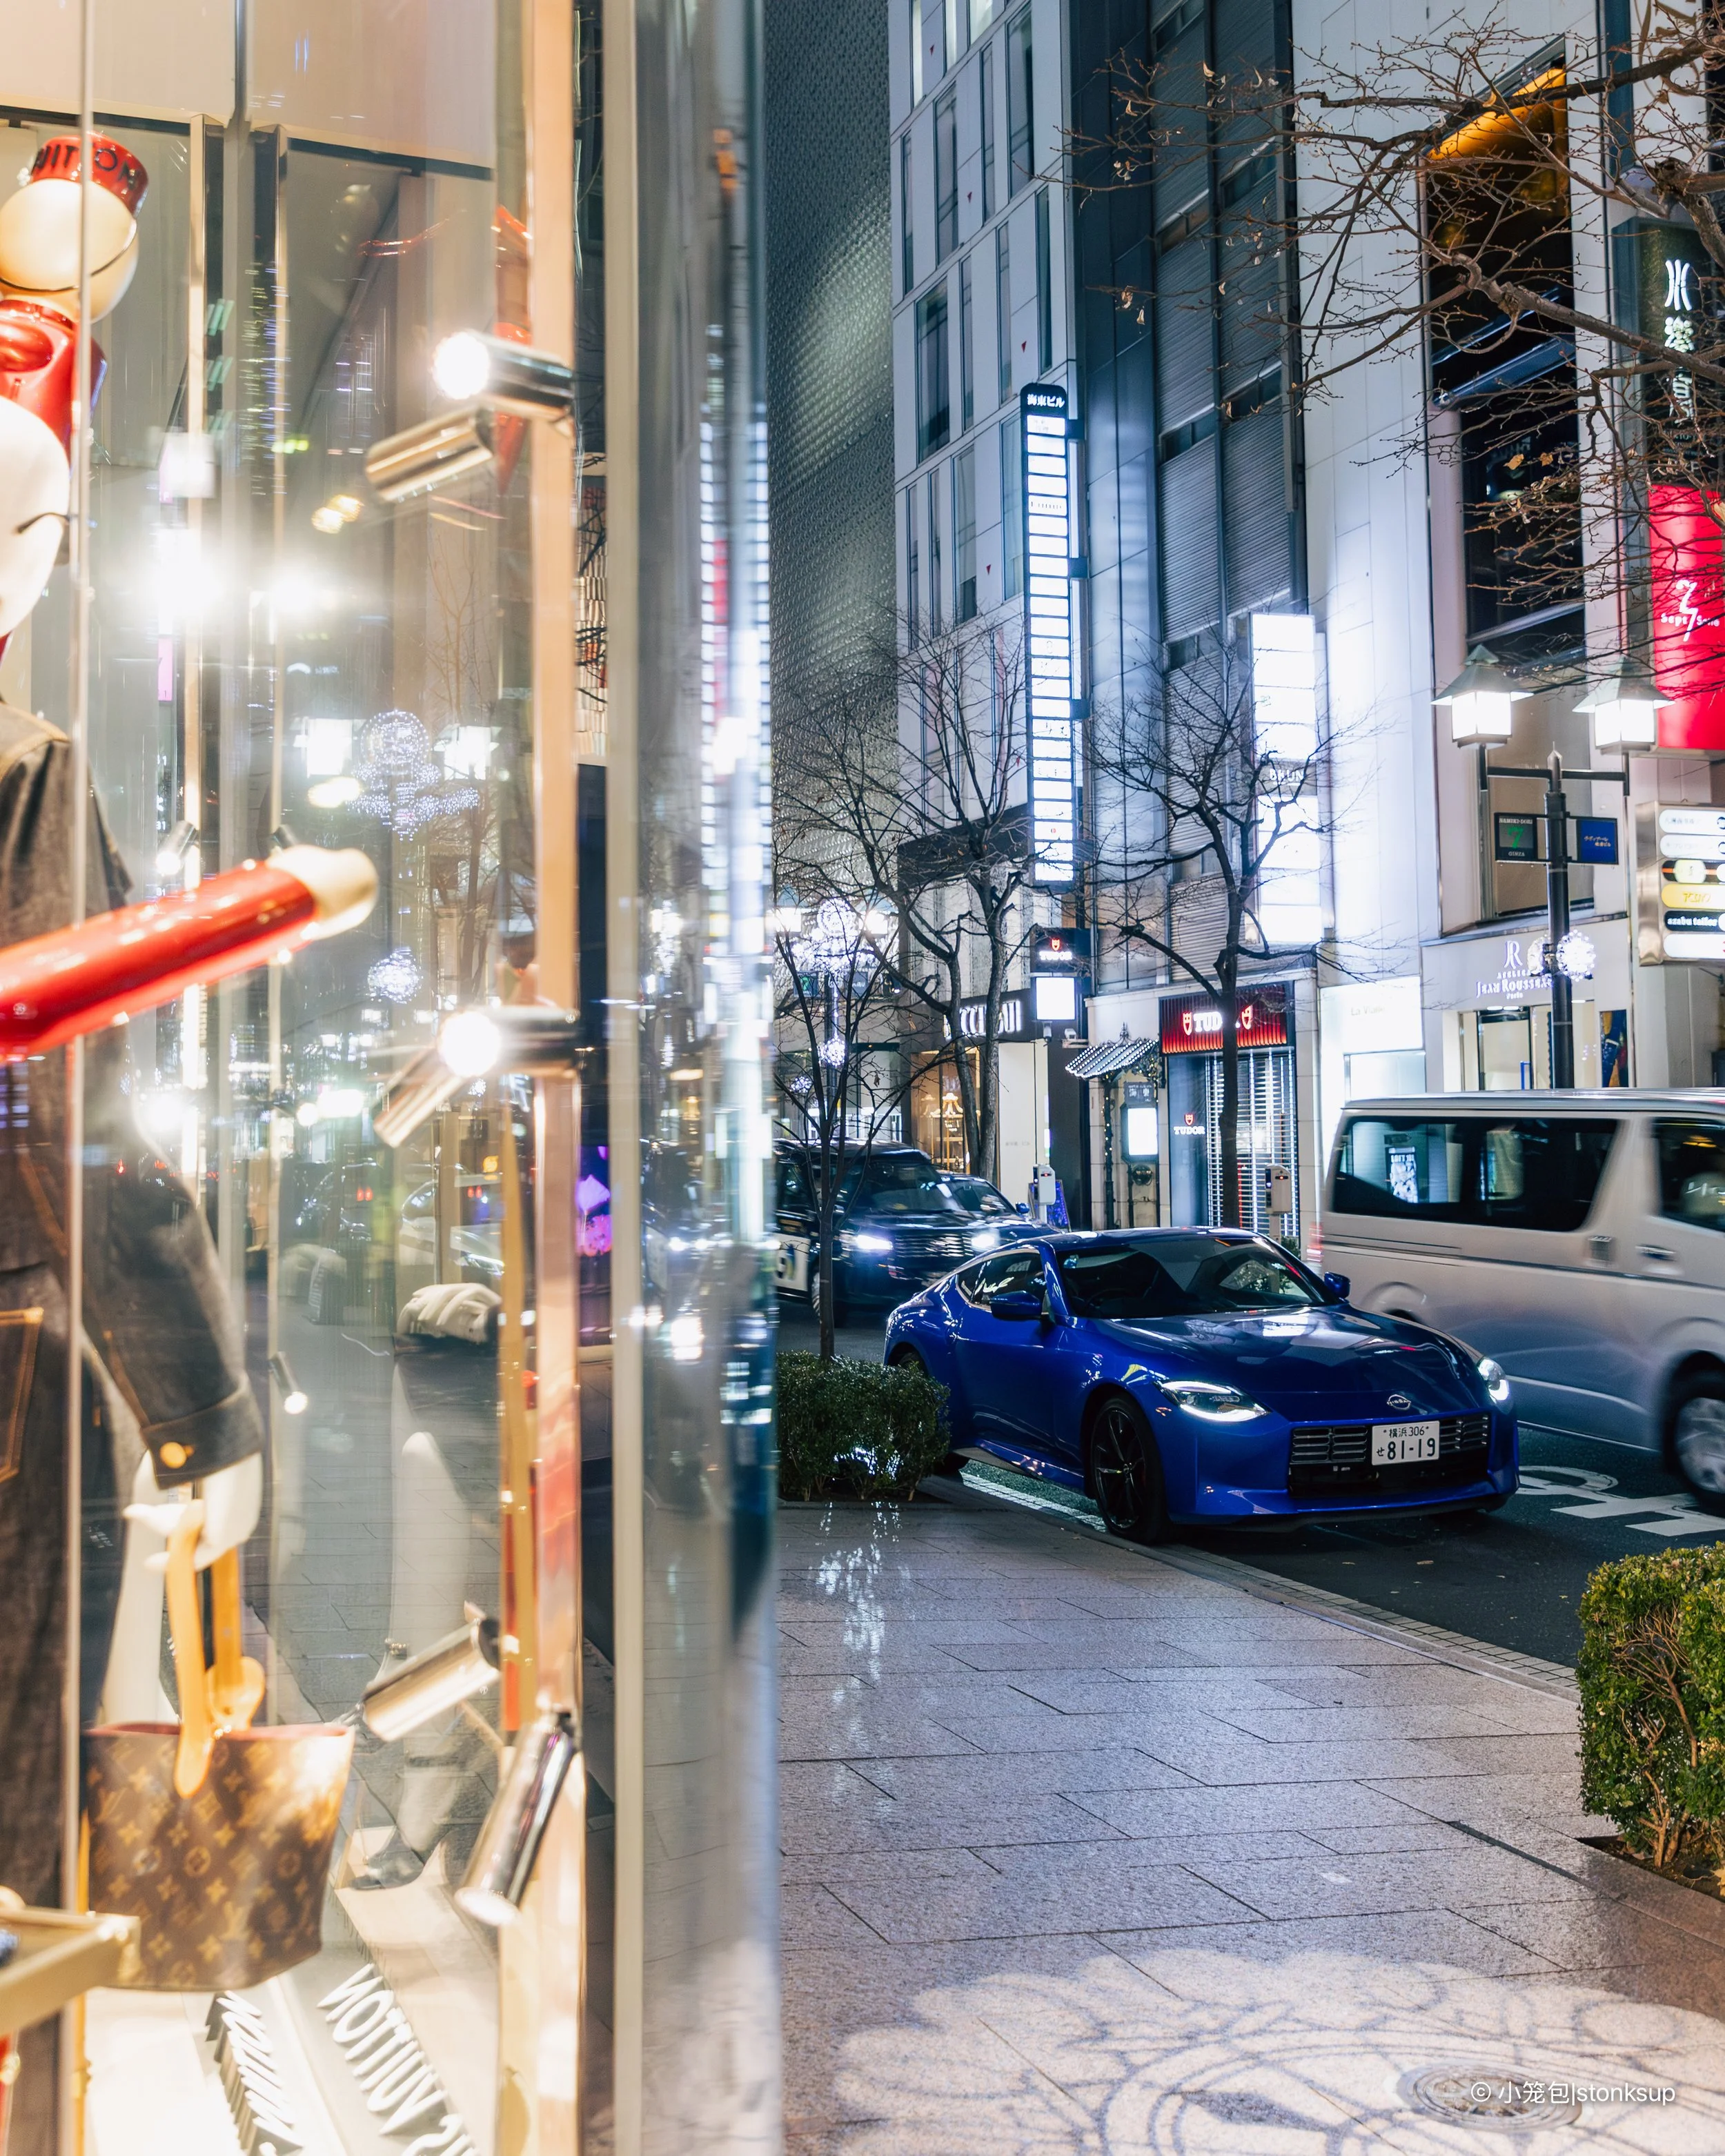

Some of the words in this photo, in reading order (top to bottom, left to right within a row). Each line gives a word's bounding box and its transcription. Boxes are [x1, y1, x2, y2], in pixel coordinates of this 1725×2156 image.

[1507, 826, 1524, 849] 7
[1038, 951, 1073, 960] TUDOR
[1193, 1011, 1241, 1033] TUD
[1173, 1125, 1206, 1135] TUDOR
[1387, 1437, 1436, 1461] 81-19
